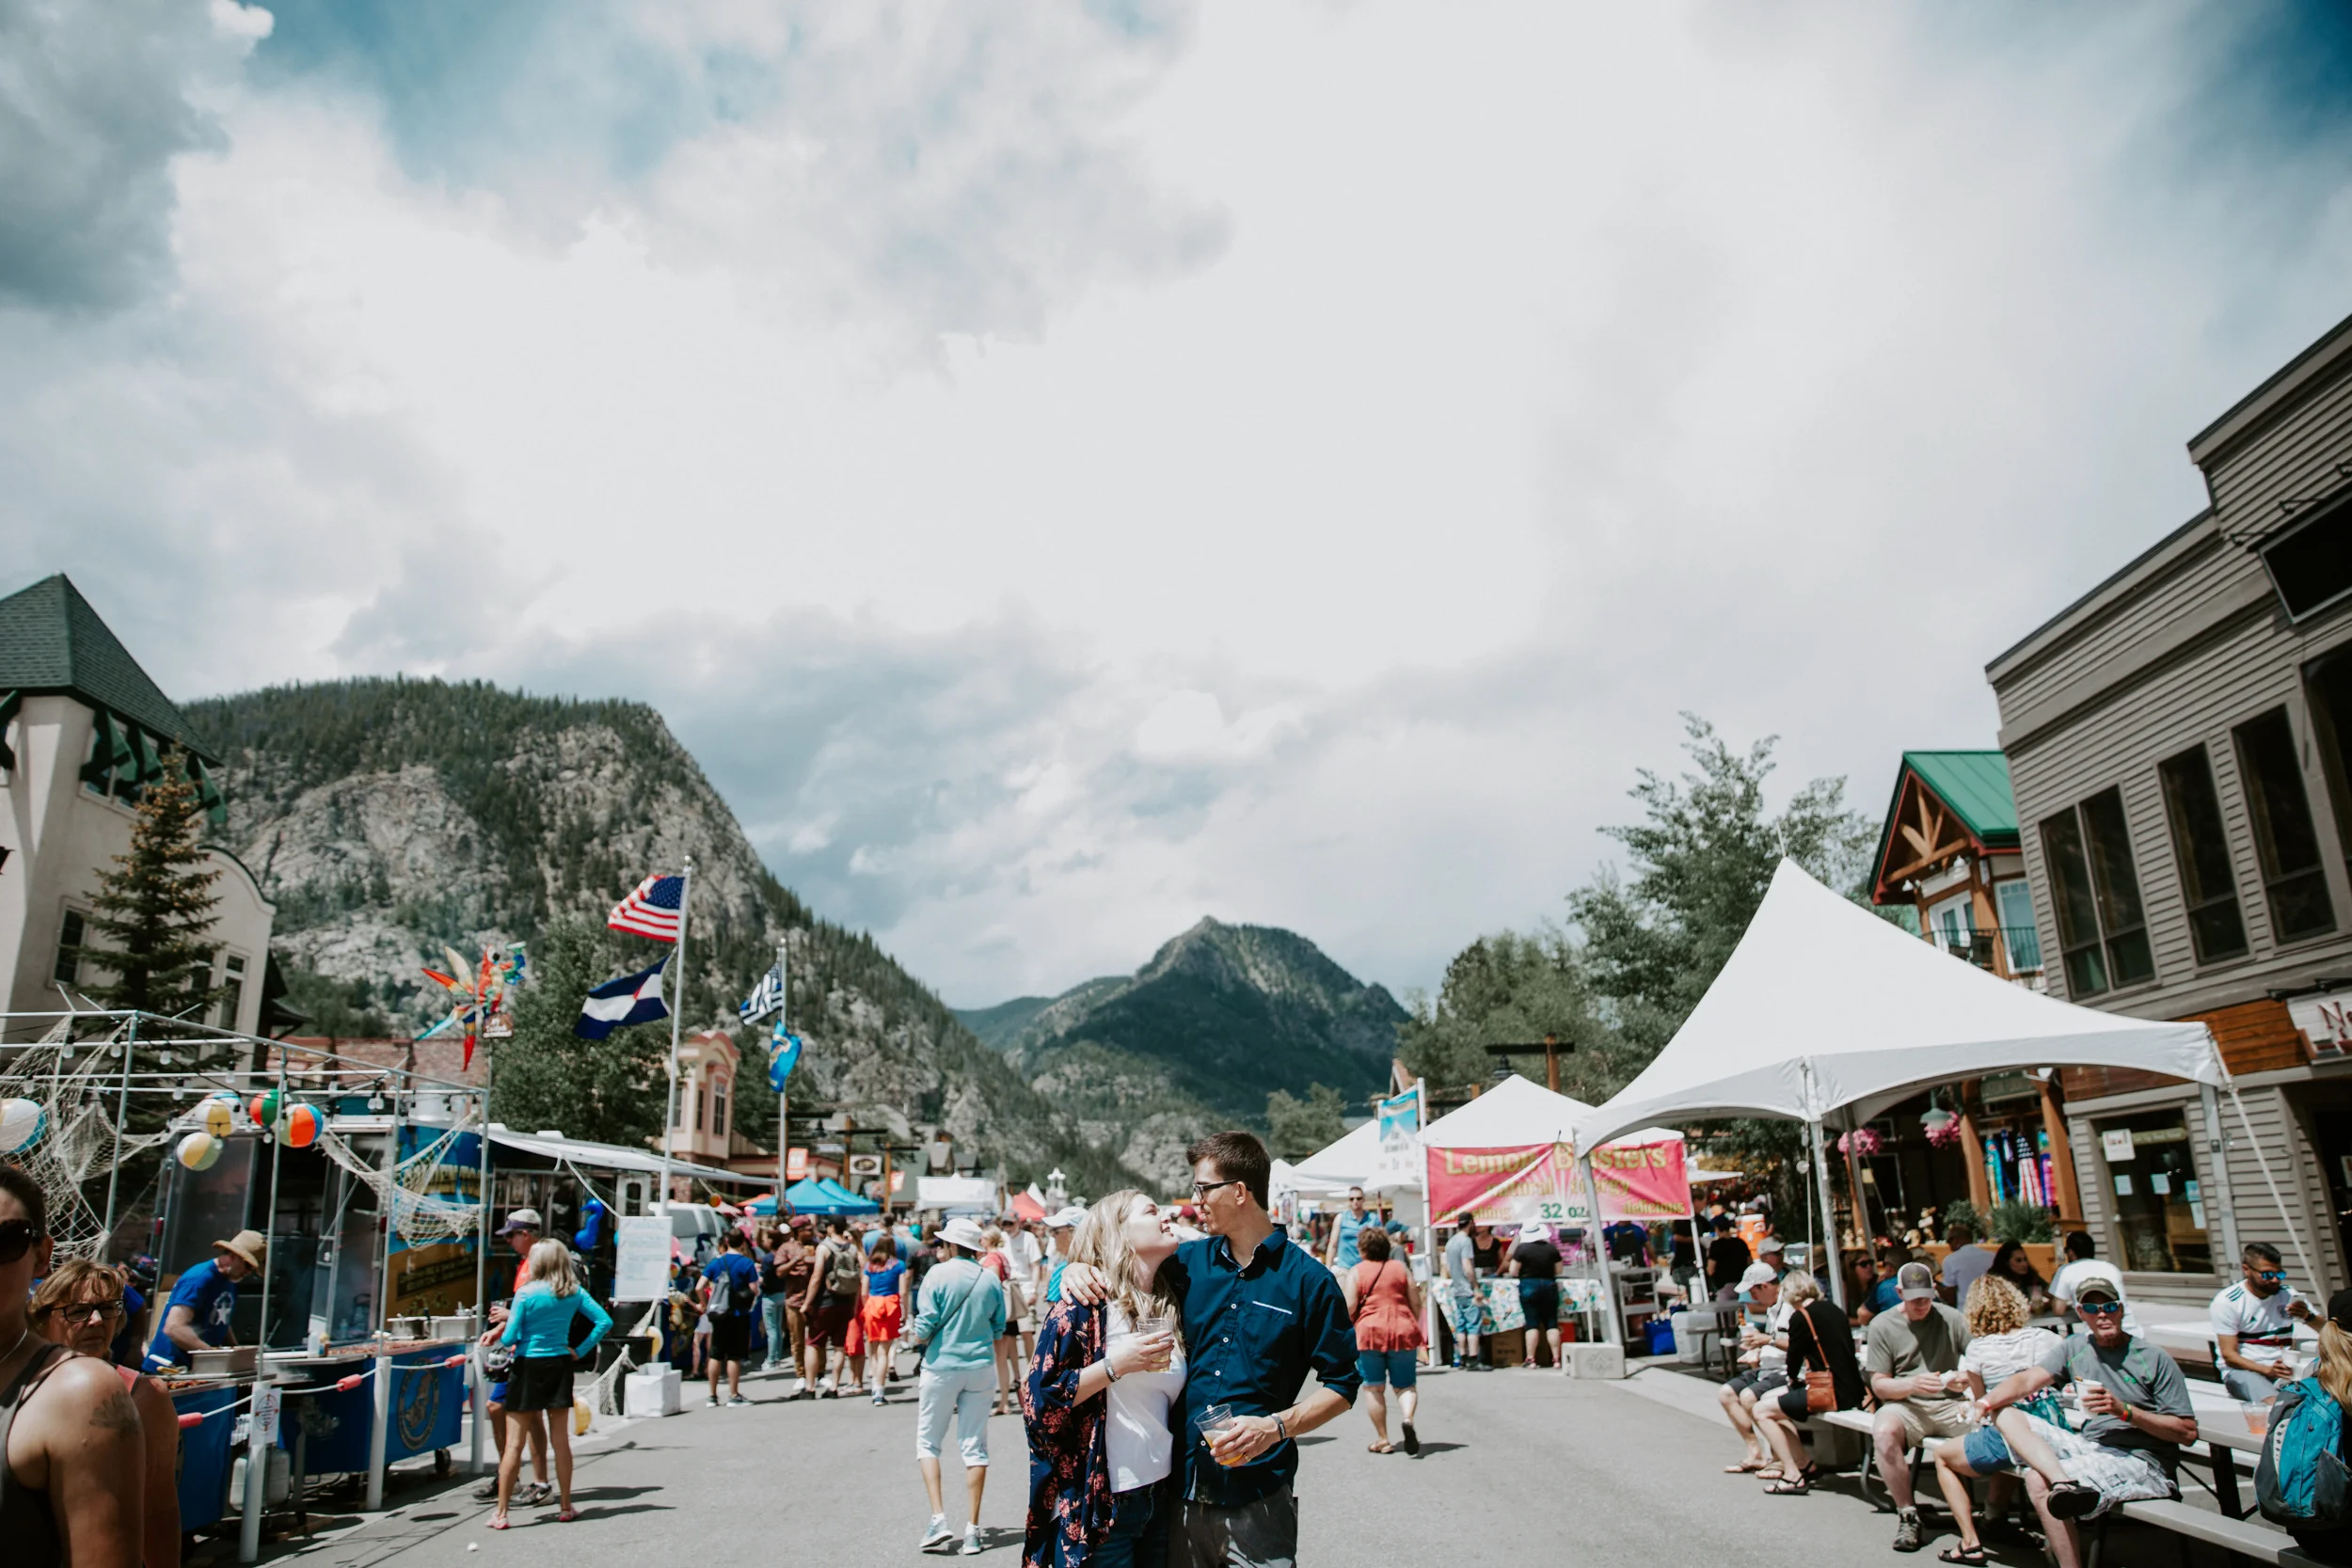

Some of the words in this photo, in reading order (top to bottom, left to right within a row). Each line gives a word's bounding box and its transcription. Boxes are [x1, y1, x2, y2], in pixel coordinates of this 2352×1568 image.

[1444, 1148, 1537, 1176] Lemon
[1540, 1203, 1562, 1219] 32
[1623, 1199, 1685, 1214] delicious
